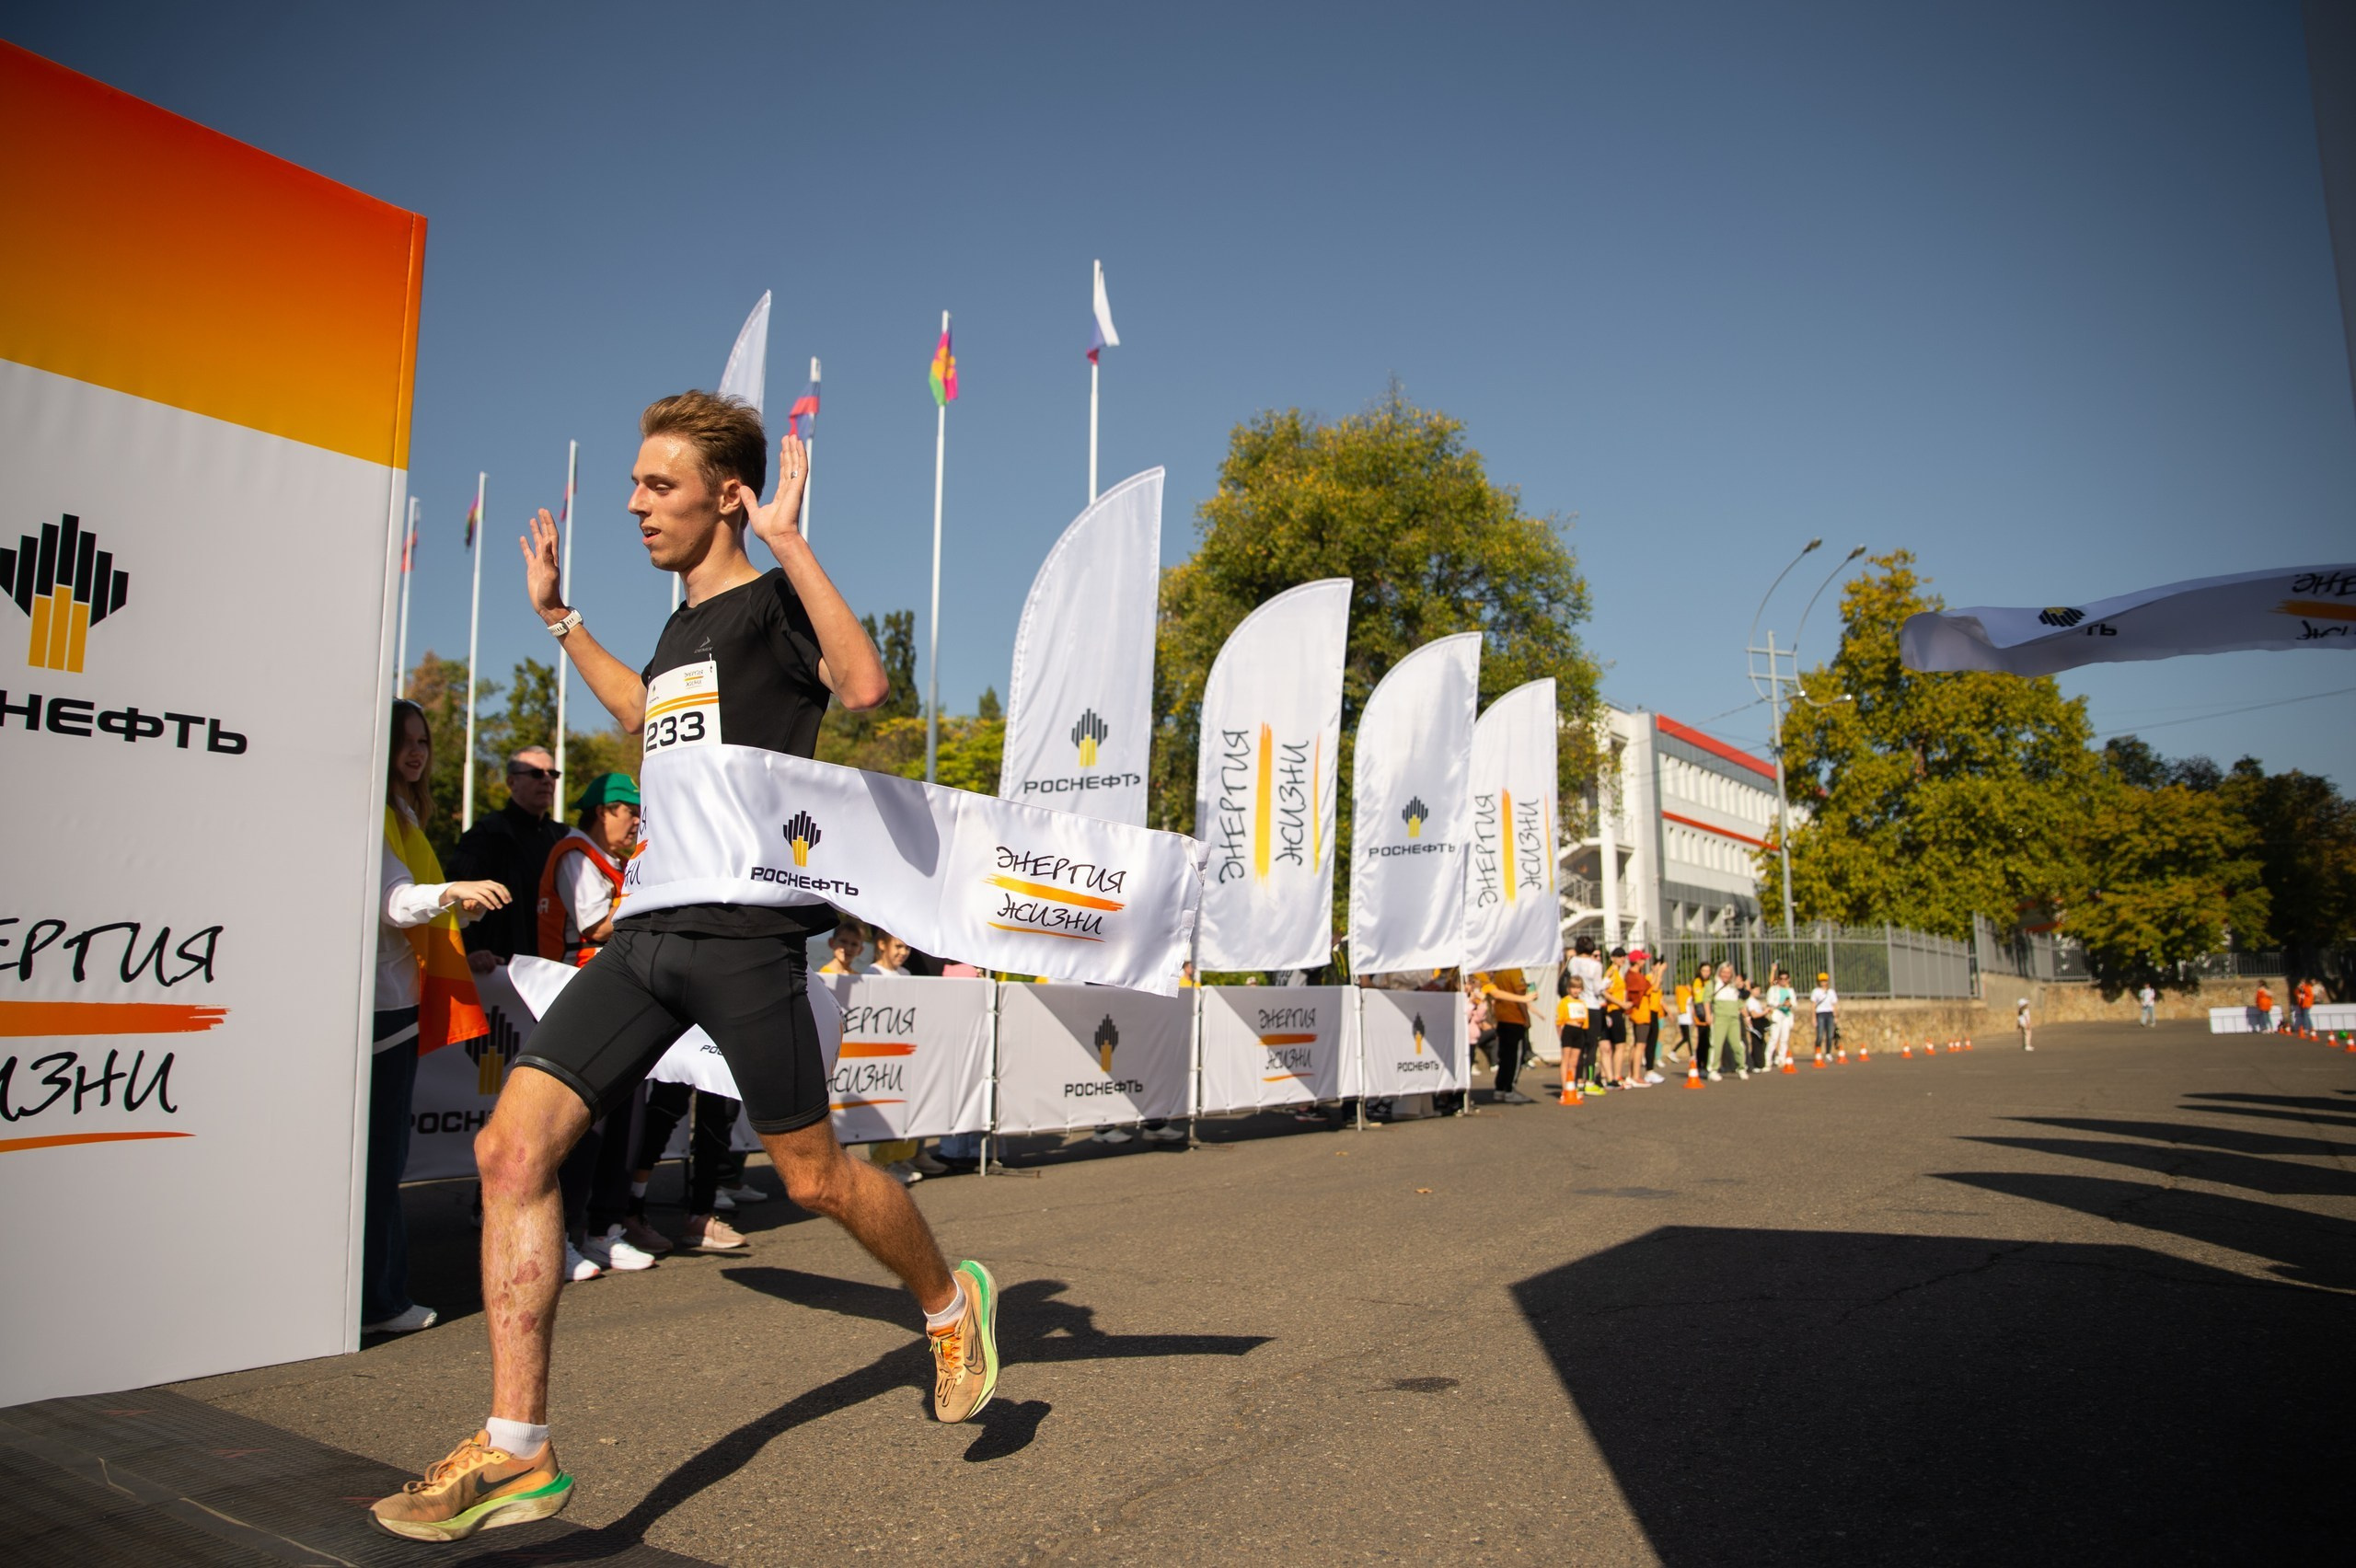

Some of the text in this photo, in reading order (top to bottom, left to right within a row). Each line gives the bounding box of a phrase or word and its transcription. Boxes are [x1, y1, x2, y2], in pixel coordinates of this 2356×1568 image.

[645, 711, 706, 752] 233
[1218, 730, 1251, 884] ЭНЕРГИЯ
[1275, 740, 1309, 866] ЖИЗНИ
[1369, 843, 1455, 858] РОСНЕФТЬ
[1474, 794, 1498, 908] ЭНЕРГИЯ
[1519, 799, 1542, 891] ЖИЗНИ
[750, 867, 859, 896] РОСНЕФТЬ
[996, 846, 1126, 894] ЭНЕРГИЯ
[997, 893, 1103, 935] ЖИЗНИ
[1258, 1008, 1316, 1029] ЭНЕРГИЯ
[1265, 1048, 1312, 1070] ЖИЗНИ
[1397, 1061, 1439, 1073] РОСНЕФТЬ
[1064, 1079, 1143, 1097] РОСНЕФТЬ
